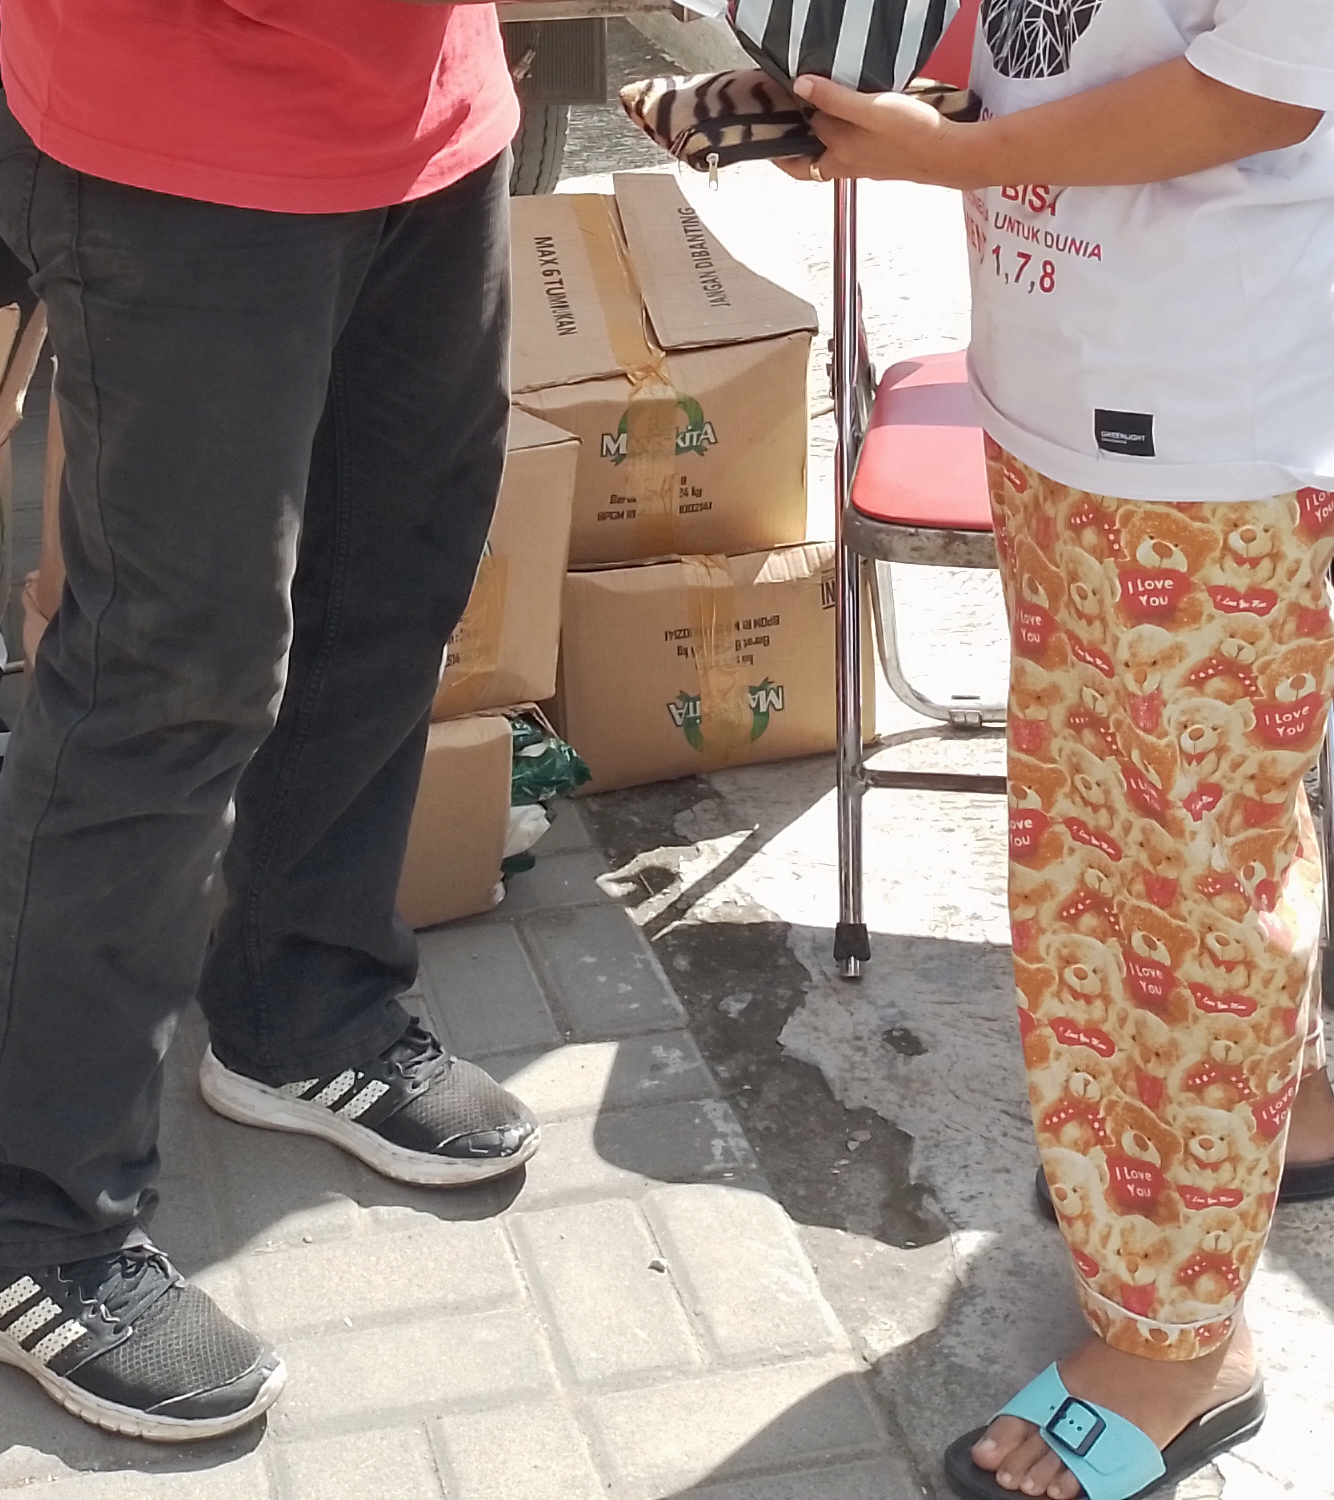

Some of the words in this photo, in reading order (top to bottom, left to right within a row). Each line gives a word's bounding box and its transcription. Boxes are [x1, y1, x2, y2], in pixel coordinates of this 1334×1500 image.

[676, 206, 715, 271] DIBANTING
[994, 211, 1041, 246] UNTUK
[1044, 231, 1103, 263] DUNIA
[534, 235, 559, 267] MAX
[542, 267, 562, 278] 6
[700, 270, 731, 308] JANGAN
[1137, 578, 1174, 592] Love
[1139, 595, 1169, 608] You
[1020, 629, 1041, 644] You
[1275, 705, 1310, 724] Love
[1276, 722, 1305, 738] You
[1010, 819, 1033, 830] ove
[1136, 963, 1164, 981] Love
[1139, 981, 1163, 996] You
[1124, 1167, 1153, 1182] Love
[1127, 1184, 1152, 1197] You
